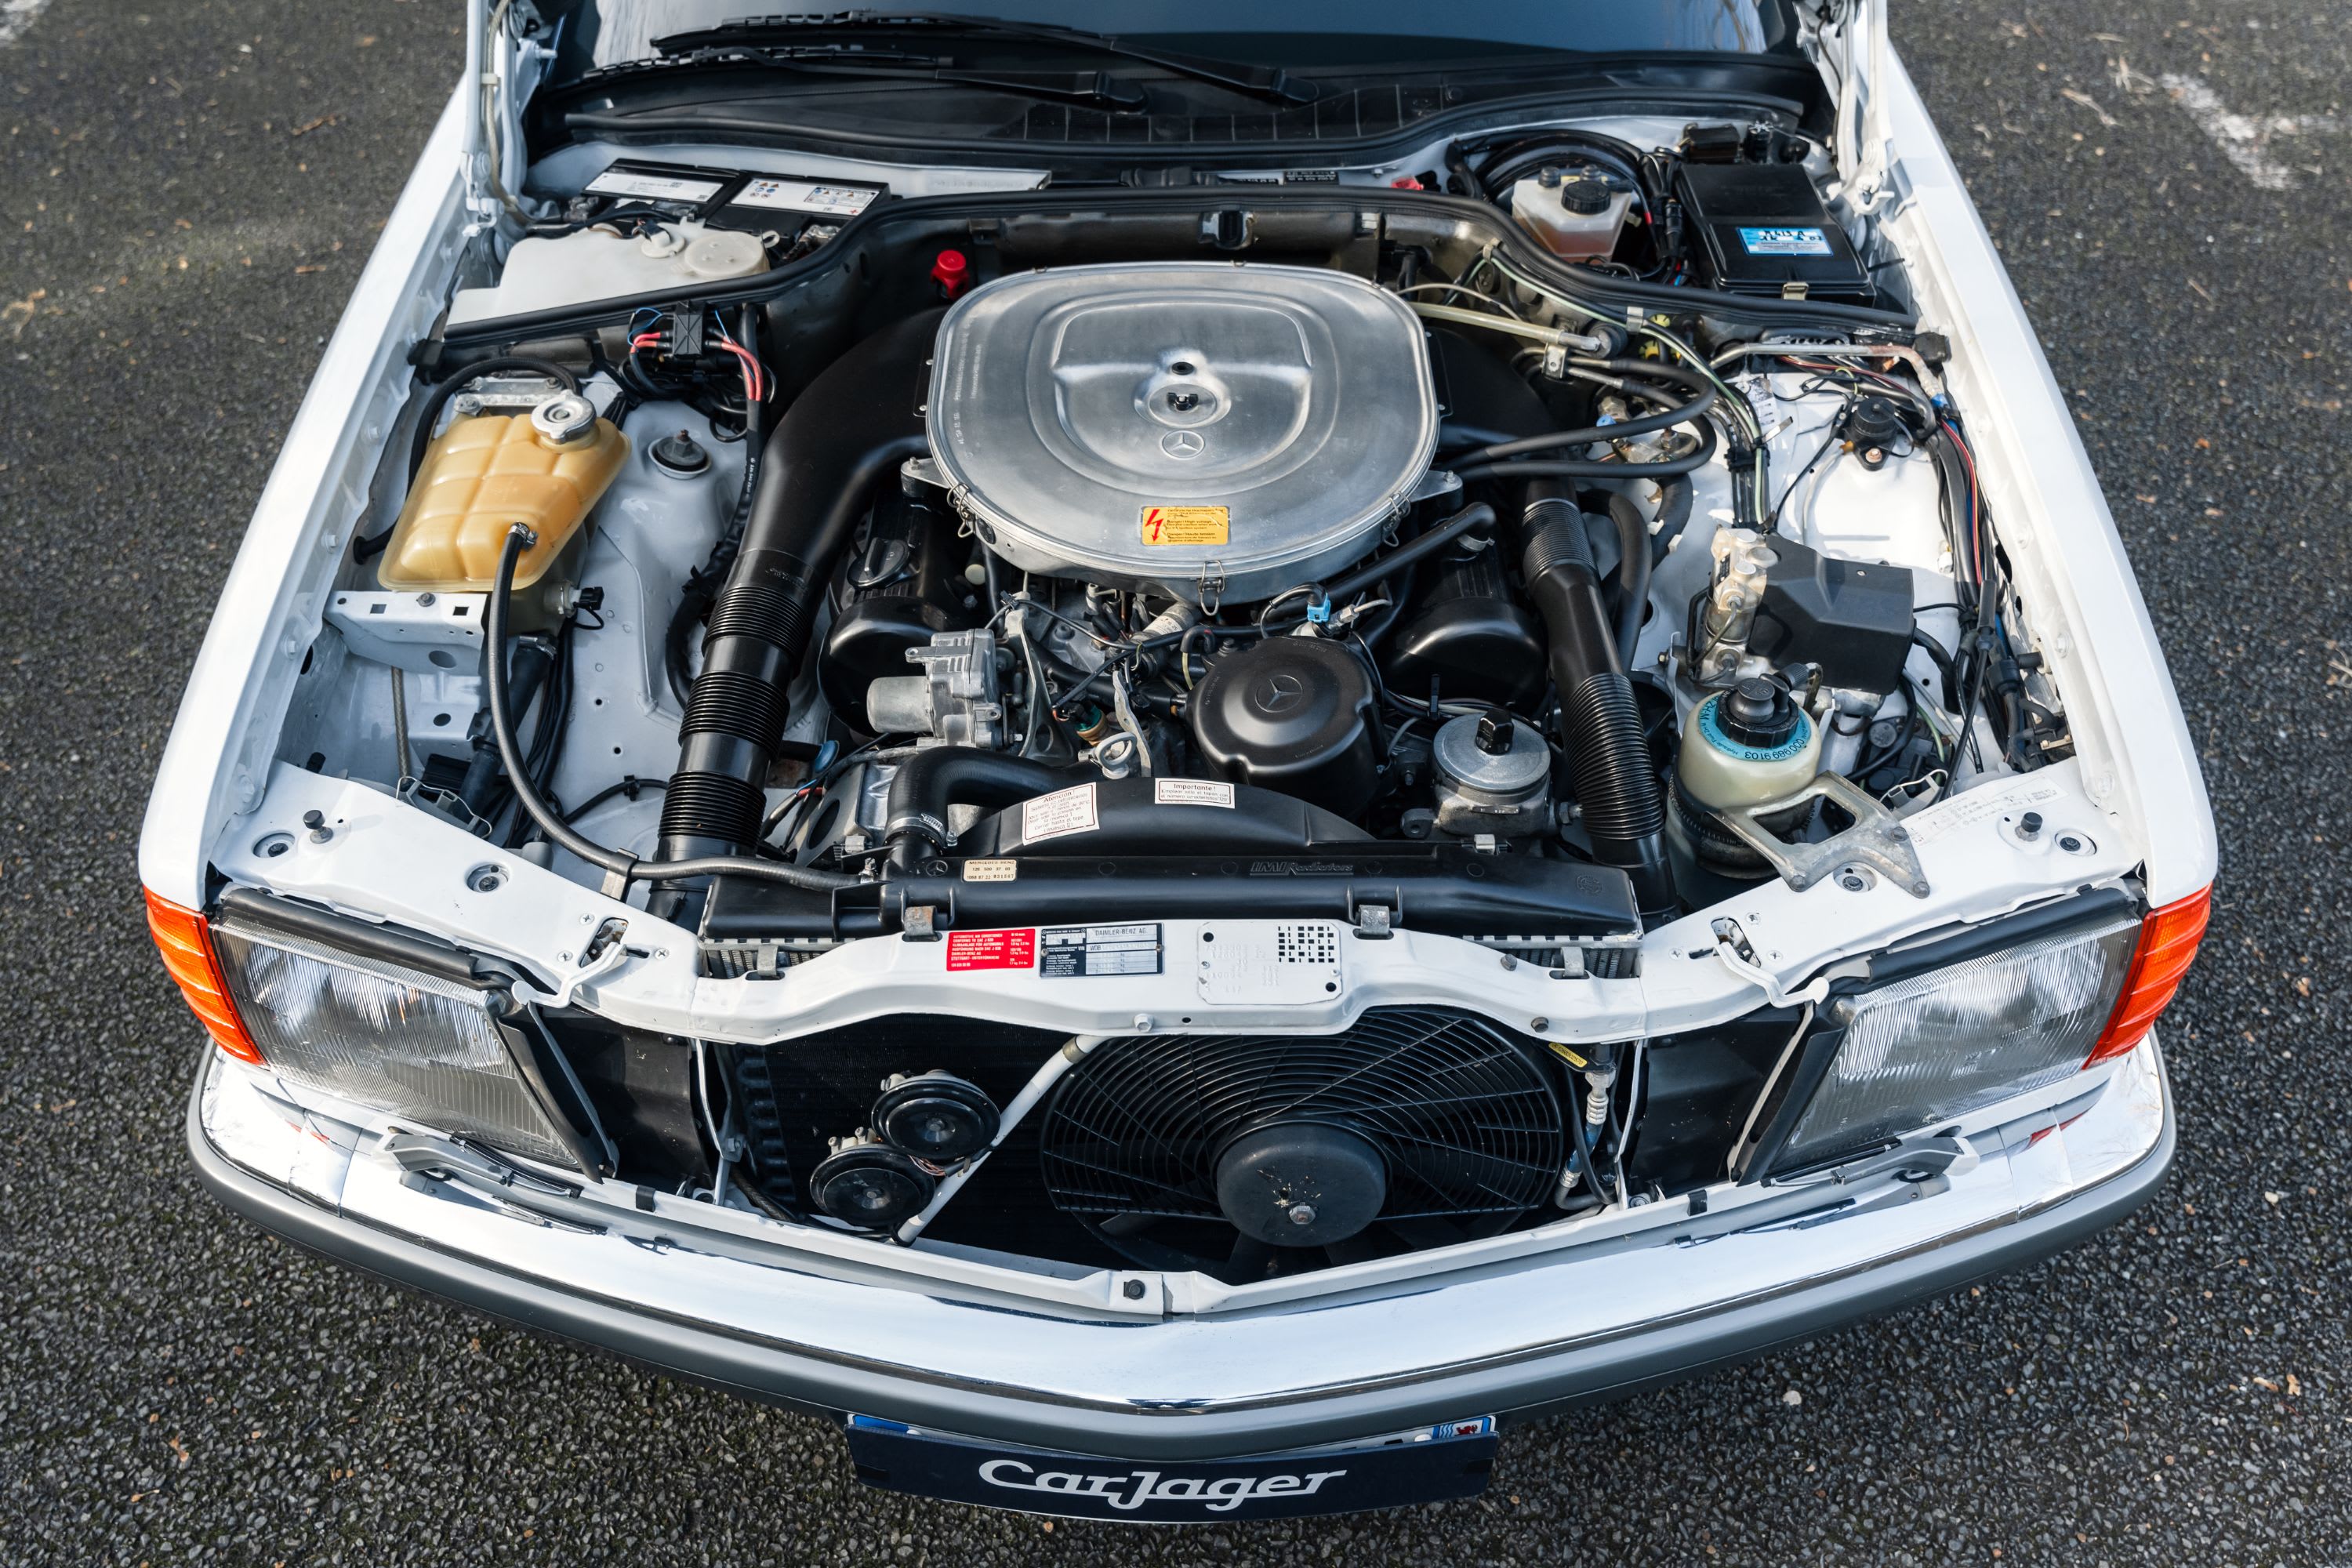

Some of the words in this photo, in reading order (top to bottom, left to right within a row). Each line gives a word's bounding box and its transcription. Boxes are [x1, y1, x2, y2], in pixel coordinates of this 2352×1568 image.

[1789, 739, 1805, 752] 000
[1773, 748, 1791, 760] 989
[1044, 792, 1072, 803] Atención
[978, 1459, 1347, 1511] CarJager
